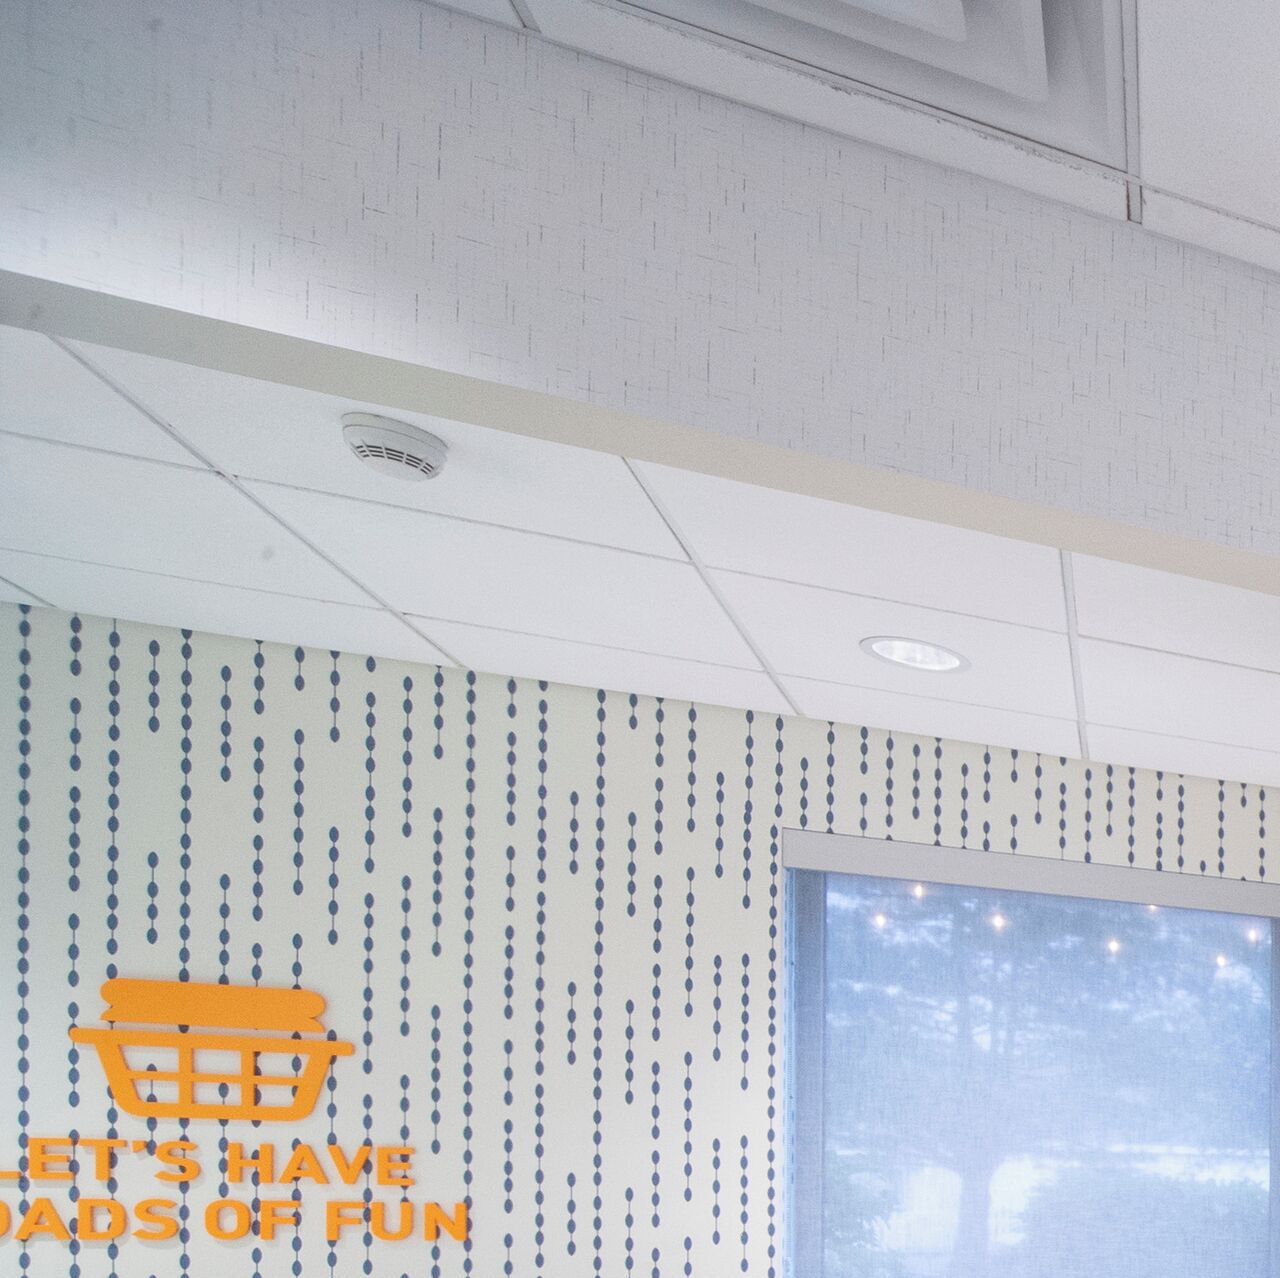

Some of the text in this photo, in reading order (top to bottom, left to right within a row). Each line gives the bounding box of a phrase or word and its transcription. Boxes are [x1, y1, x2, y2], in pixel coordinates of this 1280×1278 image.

[227, 1142, 416, 1186] HAVE
[0, 1197, 469, 1241] ADS OF FUN
